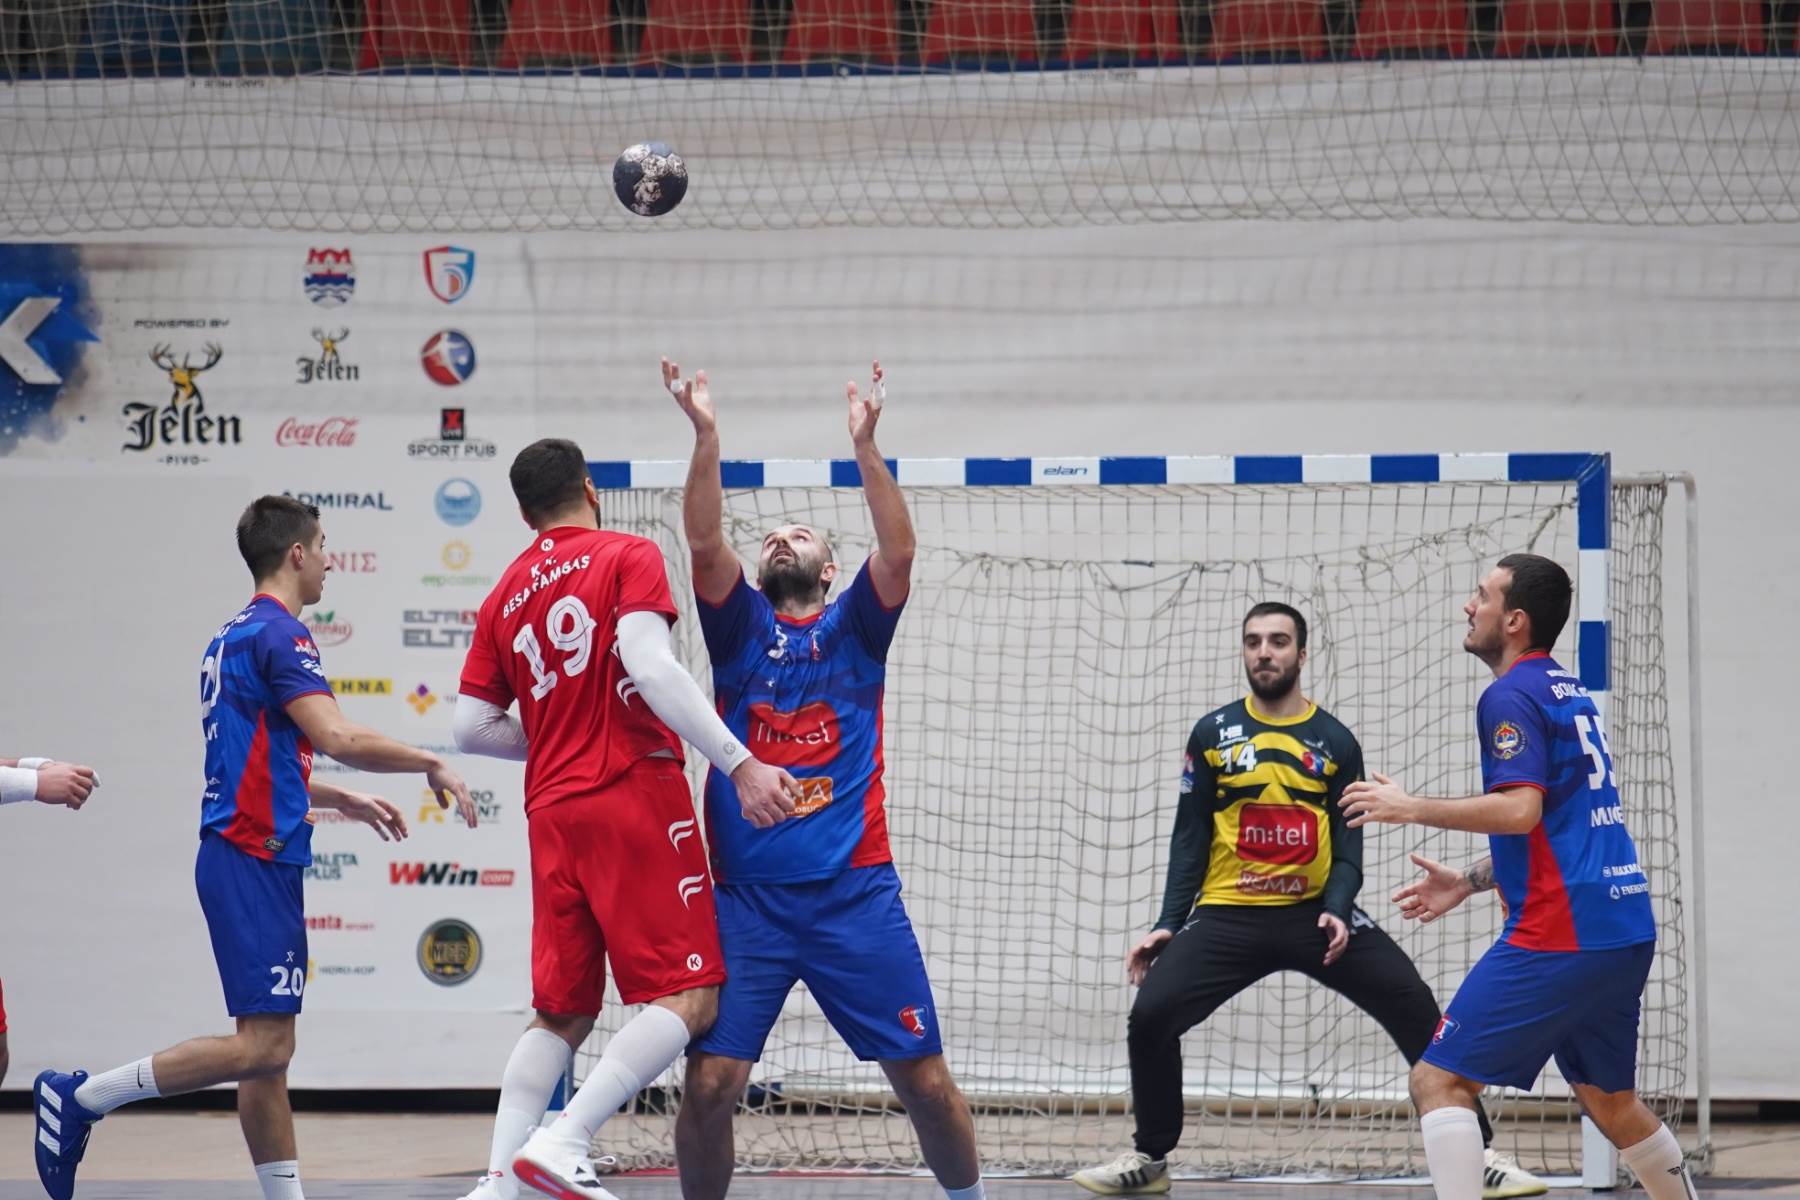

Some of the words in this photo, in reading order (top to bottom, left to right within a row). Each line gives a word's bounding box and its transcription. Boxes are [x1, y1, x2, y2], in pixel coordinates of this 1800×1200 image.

[134, 319, 205, 328] POWERED
[209, 319, 230, 328] BY
[295, 357, 359, 384] Jelen
[122, 402, 242, 452] Jelen
[407, 444, 460, 457] SPORT
[464, 444, 497, 458] PUB
[1043, 465, 1087, 476] elan
[282, 491, 394, 511] DMIRAL
[513, 595, 598, 700] 19
[1220, 743, 1258, 773] 14
[1244, 822, 1309, 846] m:tel
[389, 862, 479, 886] WWin
[270, 965, 304, 997] 20
